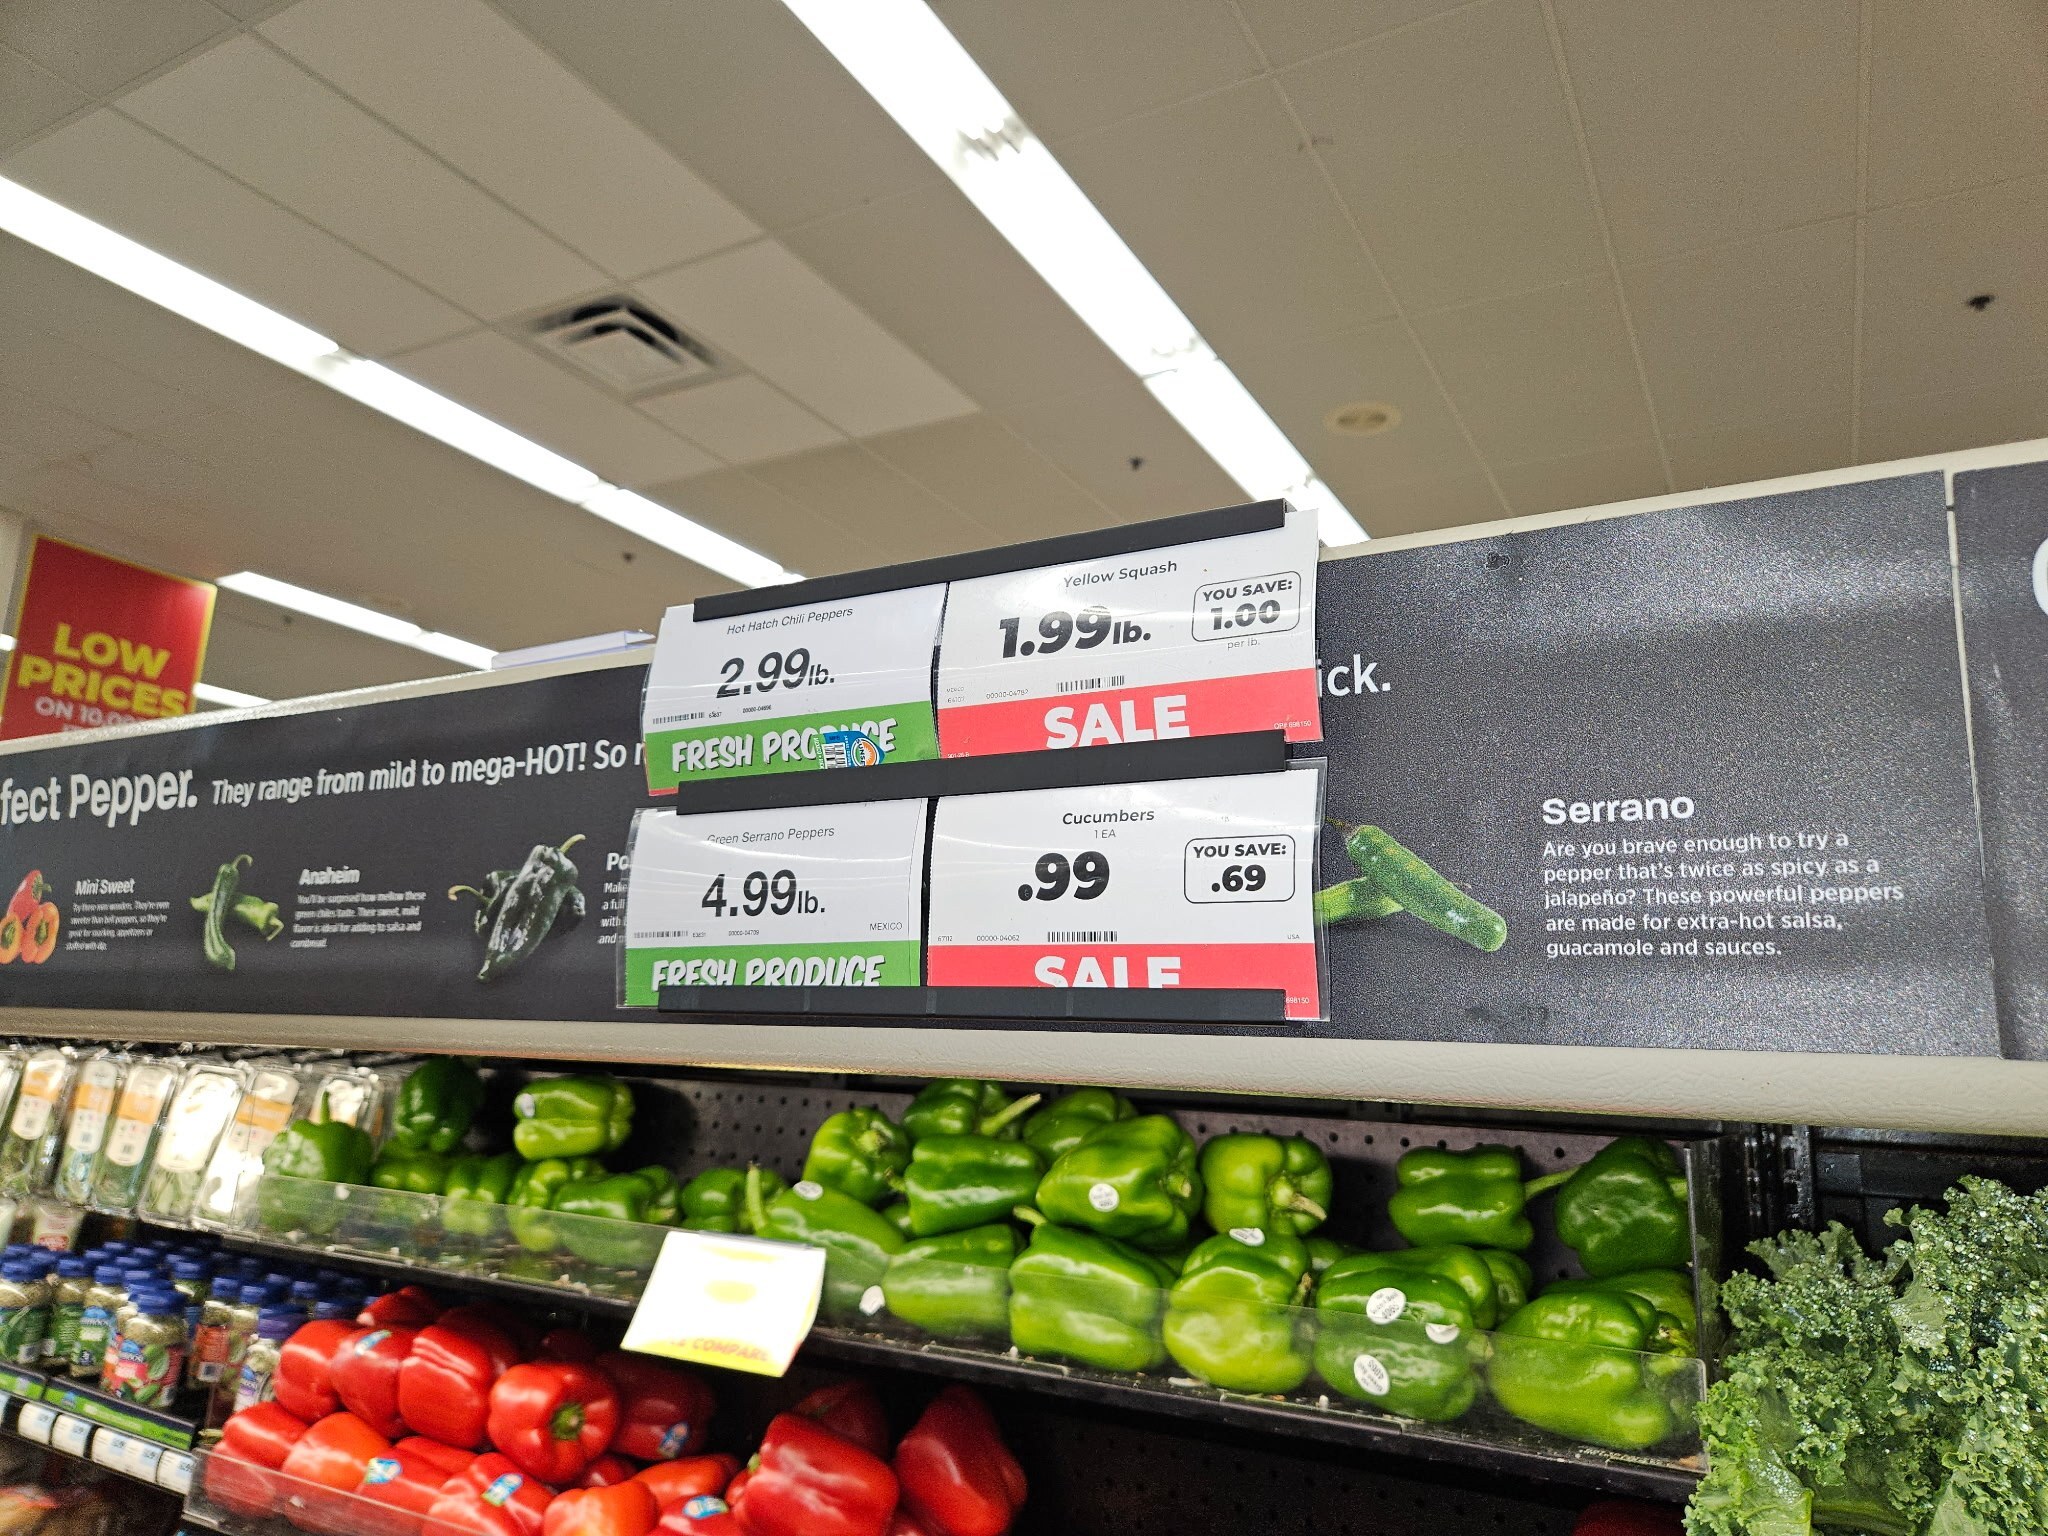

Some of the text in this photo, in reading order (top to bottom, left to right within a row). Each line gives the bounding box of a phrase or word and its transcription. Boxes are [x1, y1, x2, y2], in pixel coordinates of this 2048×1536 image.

[1063, 561, 1178, 588] Yellow Squash
[1203, 579, 1293, 602] YOU SAVE:
[726, 607, 854, 635] Hot Hatch Chili Peppers
[1210, 599, 1281, 631] 1.00
[54, 622, 171, 679] LOW
[1227, 637, 1261, 651] per lb.
[17, 654, 188, 719] PRICES
[34, 696, 74, 720] ON
[1044, 695, 1190, 750] SALE
[671, 733, 754, 774] FRESH
[762, 718, 899, 765] PROCE
[212, 780, 255, 808] They
[258, 775, 313, 804] range
[317, 768, 364, 796] from
[369, 759, 416, 790] mild
[422, 762, 445, 784] to
[451, 743, 586, 785] mega-HOT!
[592, 739, 627, 769] So
[69, 769, 198, 828] Pepper.
[1542, 796, 1695, 825] Serrano
[1062, 808, 1155, 826] Cucumbers
[707, 825, 835, 845] Green Serrano Peppers
[1101, 829, 1117, 839] EA
[1543, 832, 1849, 860] Are you brave enough to try a
[1193, 841, 1286, 859] YOU SAVE:
[298, 865, 360, 885] Anaheim
[1018, 850, 1110, 901] .99
[1211, 864, 1266, 892] .69
[1544, 858, 1880, 885] pepper that's twice as spicy as a
[75, 878, 135, 895] Mini Sweet
[1544, 883, 1905, 910] jalapeño? These powerful peppers
[869, 921, 902, 931] MEXICO
[1546, 911, 1843, 932] are made for extra-hot salsa,
[598, 933, 617, 944] and
[1546, 938, 1782, 959] guacamole and sauces.
[652, 955, 886, 992] FRESH PRODUCE
